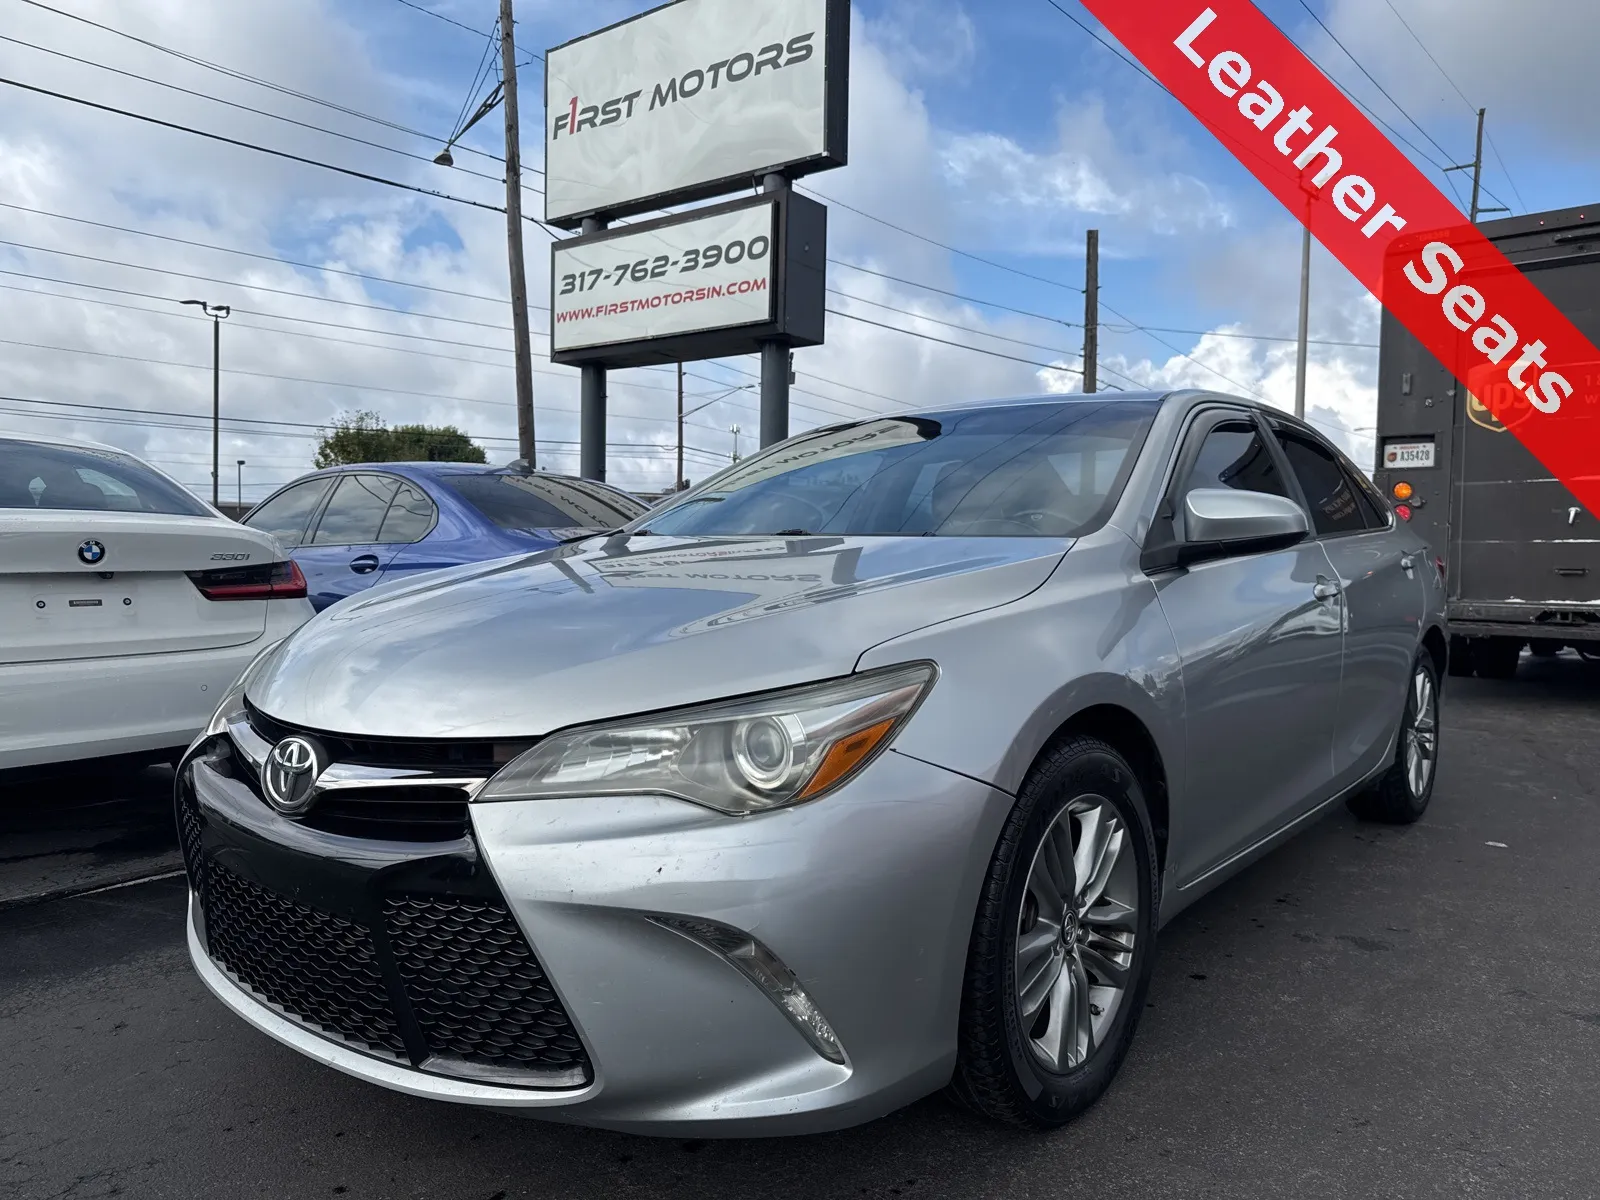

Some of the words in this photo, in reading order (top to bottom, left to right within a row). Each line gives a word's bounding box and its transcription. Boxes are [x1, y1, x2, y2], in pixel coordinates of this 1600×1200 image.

[649, 32, 815, 111] MOTORS
[559, 235, 770, 295] 317-762-3900
[556, 277, 767, 323] WWW.FIRSTMOTORSIN.COM
[1400, 450, 1430, 461] A35428
